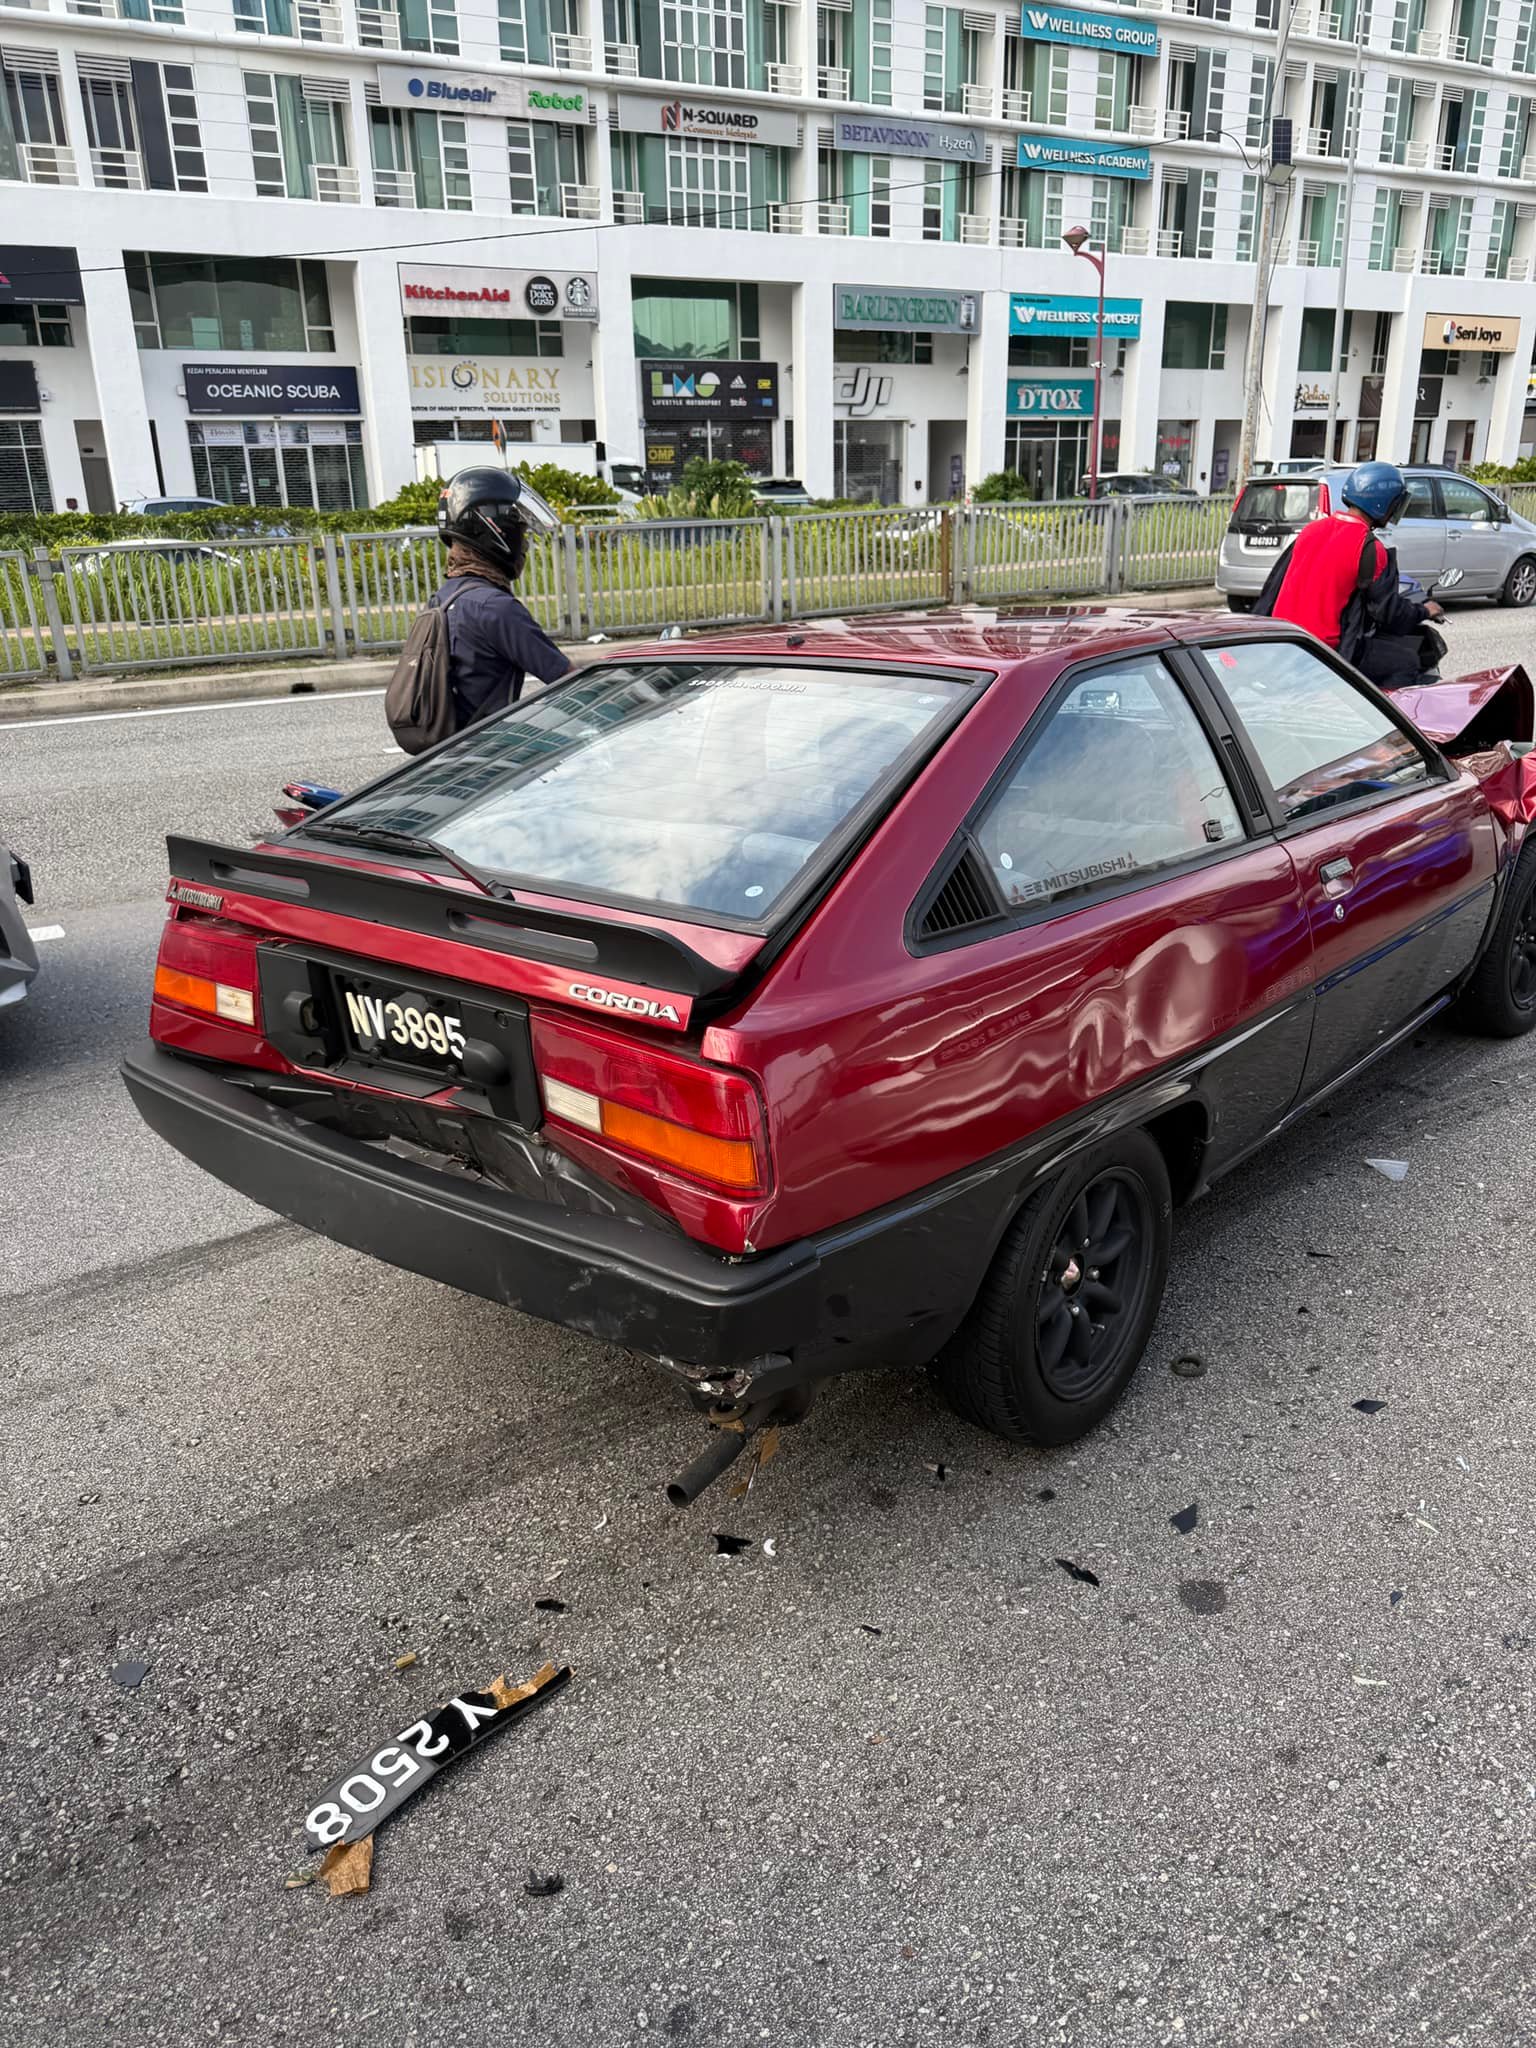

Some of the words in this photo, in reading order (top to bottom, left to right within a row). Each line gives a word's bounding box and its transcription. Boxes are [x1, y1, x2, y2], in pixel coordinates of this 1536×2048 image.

[1049, 17, 1112, 40] WELLNESS
[1115, 28, 1155, 46] GROUP
[426, 81, 497, 103] Blueair
[682, 107, 758, 128] N-SQUARED
[1042, 147, 1096, 165] WELLNESS
[1098, 154, 1148, 170] ACADEMY
[404, 284, 510, 302] KitchenAid
[1036, 310, 1091, 323] WELLNESS
[1455, 326, 1478, 340] Seni
[1478, 326, 1502, 344] Jaya
[207, 384, 283, 398] OCEANIC
[286, 384, 341, 398] SCUBA
[483, 391, 561, 404] SOLUTIONS
[648, 448, 675, 460] OMP
[1043, 857, 1127, 891] MITSUBISHI
[568, 983, 680, 1024] CORDIA
[345, 991, 467, 1060] NV3895
[449, 1697, 500, 1731] Y
[306, 1719, 450, 1844] 2508
